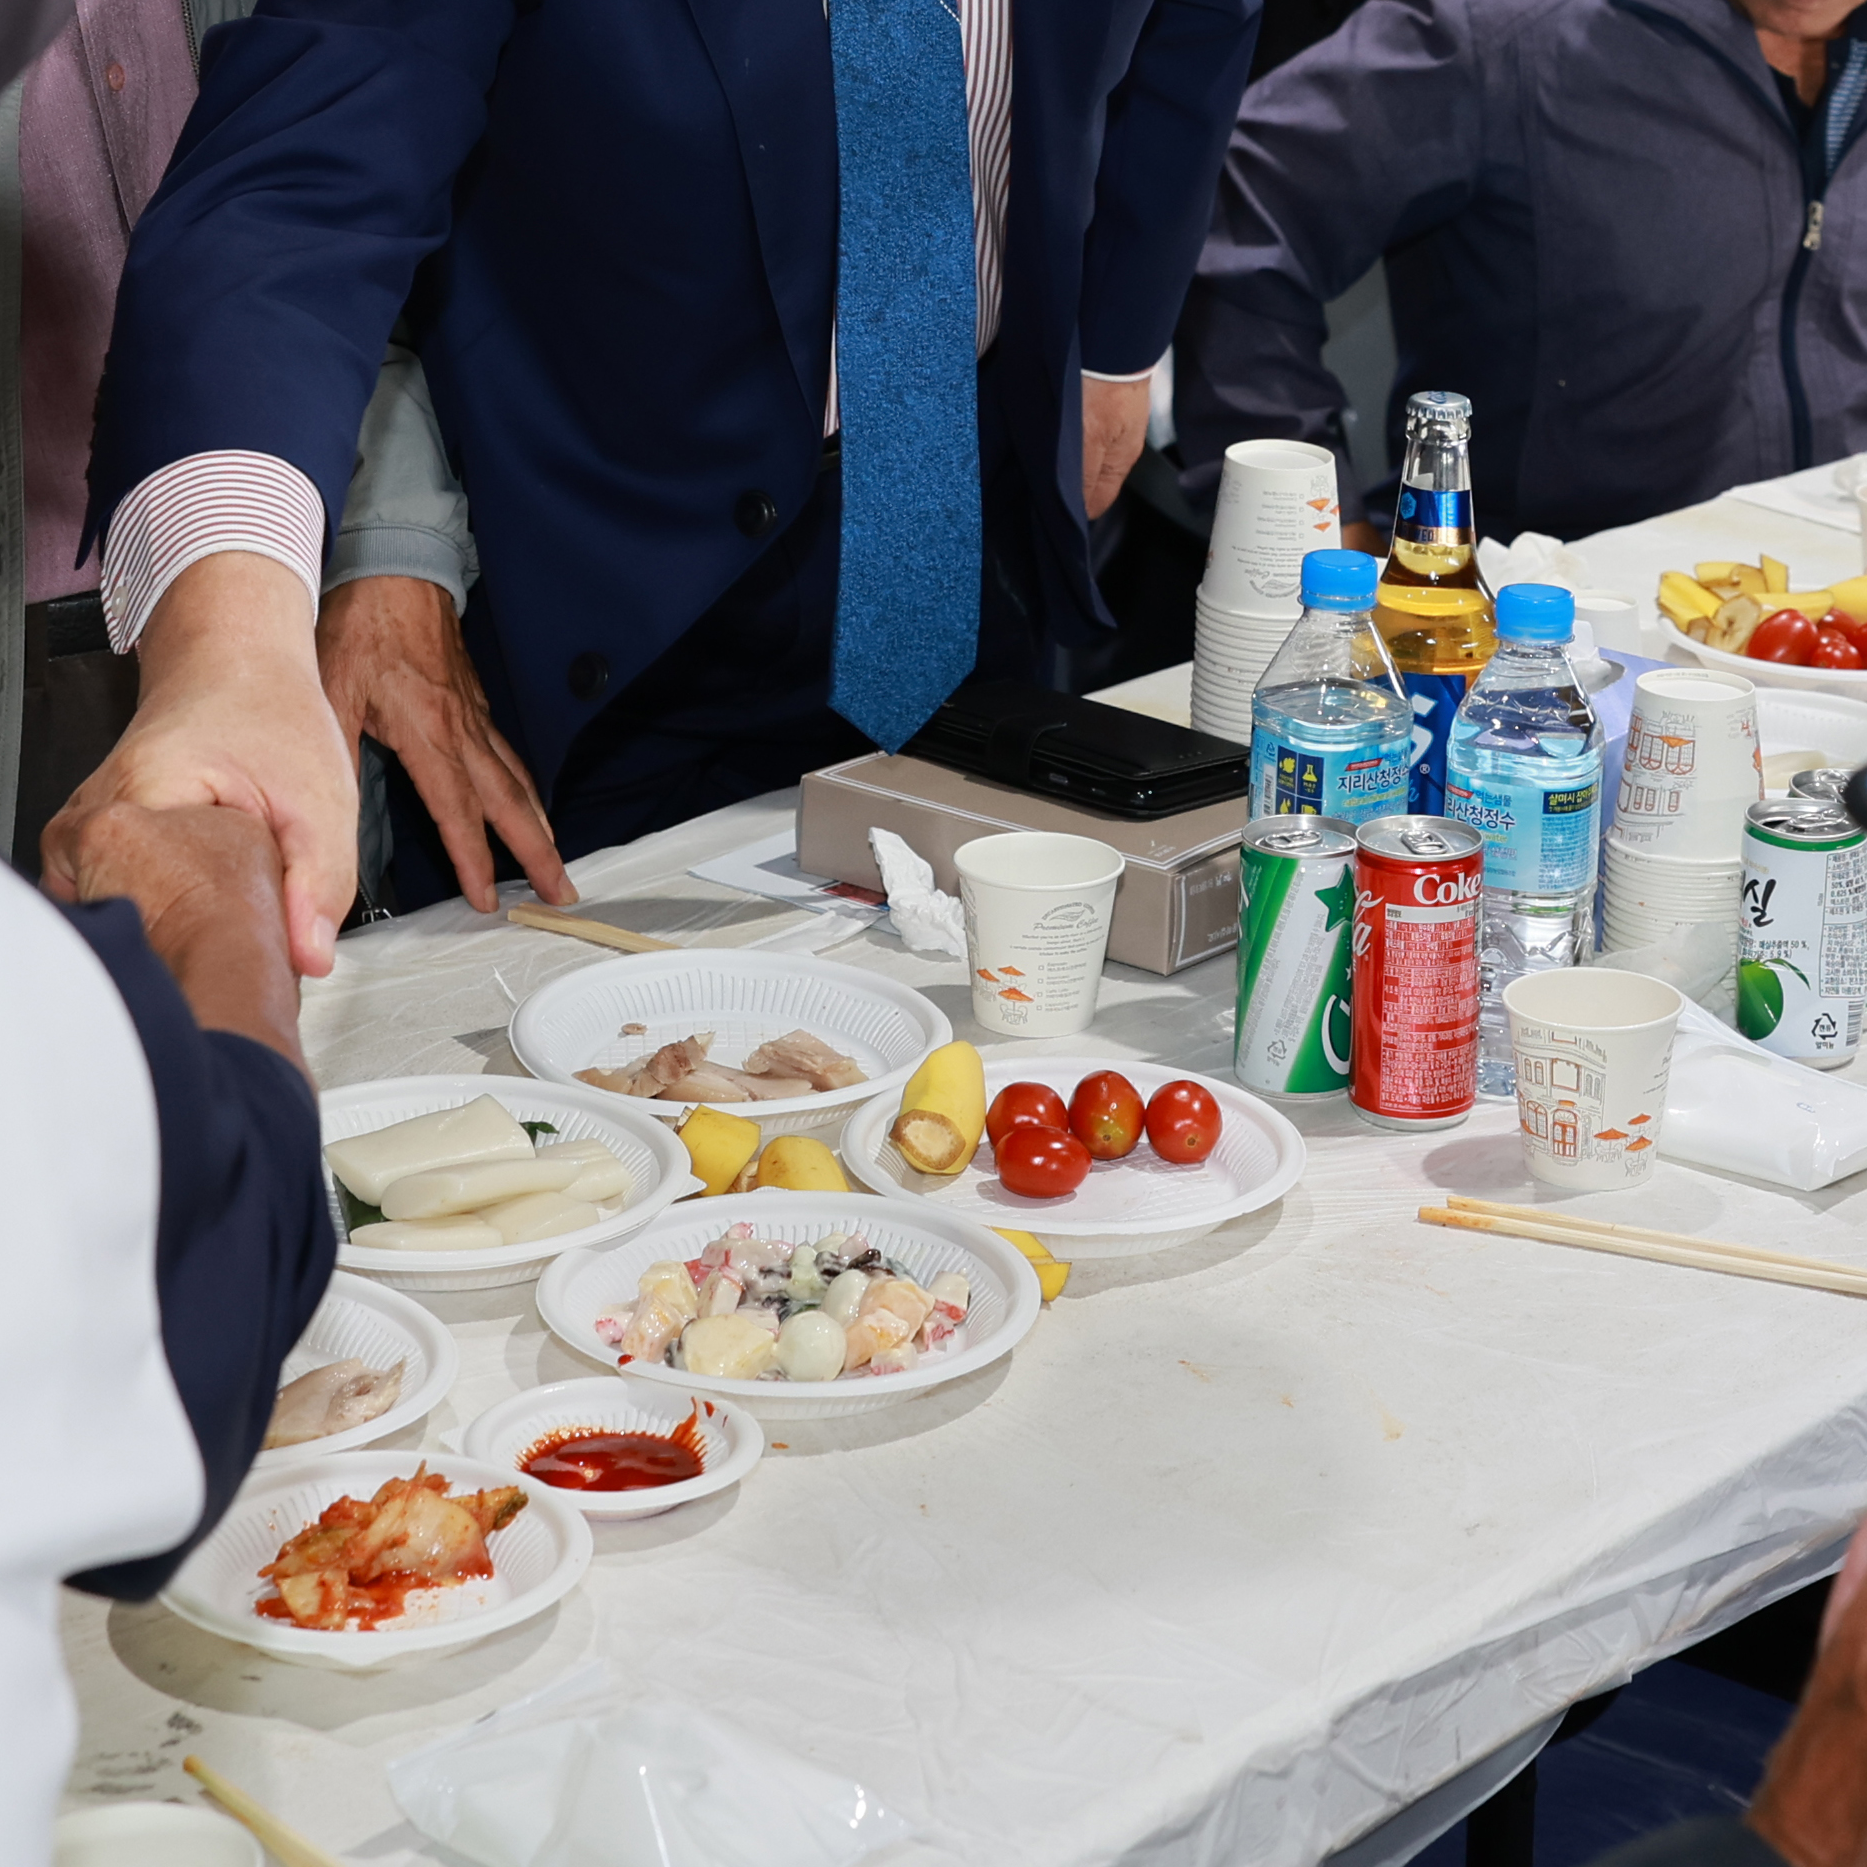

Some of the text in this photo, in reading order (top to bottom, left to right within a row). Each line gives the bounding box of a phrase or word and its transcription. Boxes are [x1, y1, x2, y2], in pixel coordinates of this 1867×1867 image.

[1446, 796, 1516, 831] 리산청정수
[1474, 789, 1513, 808] 먹는샘물
[1413, 872, 1481, 905] Coke
[1741, 873, 1777, 928] 실
